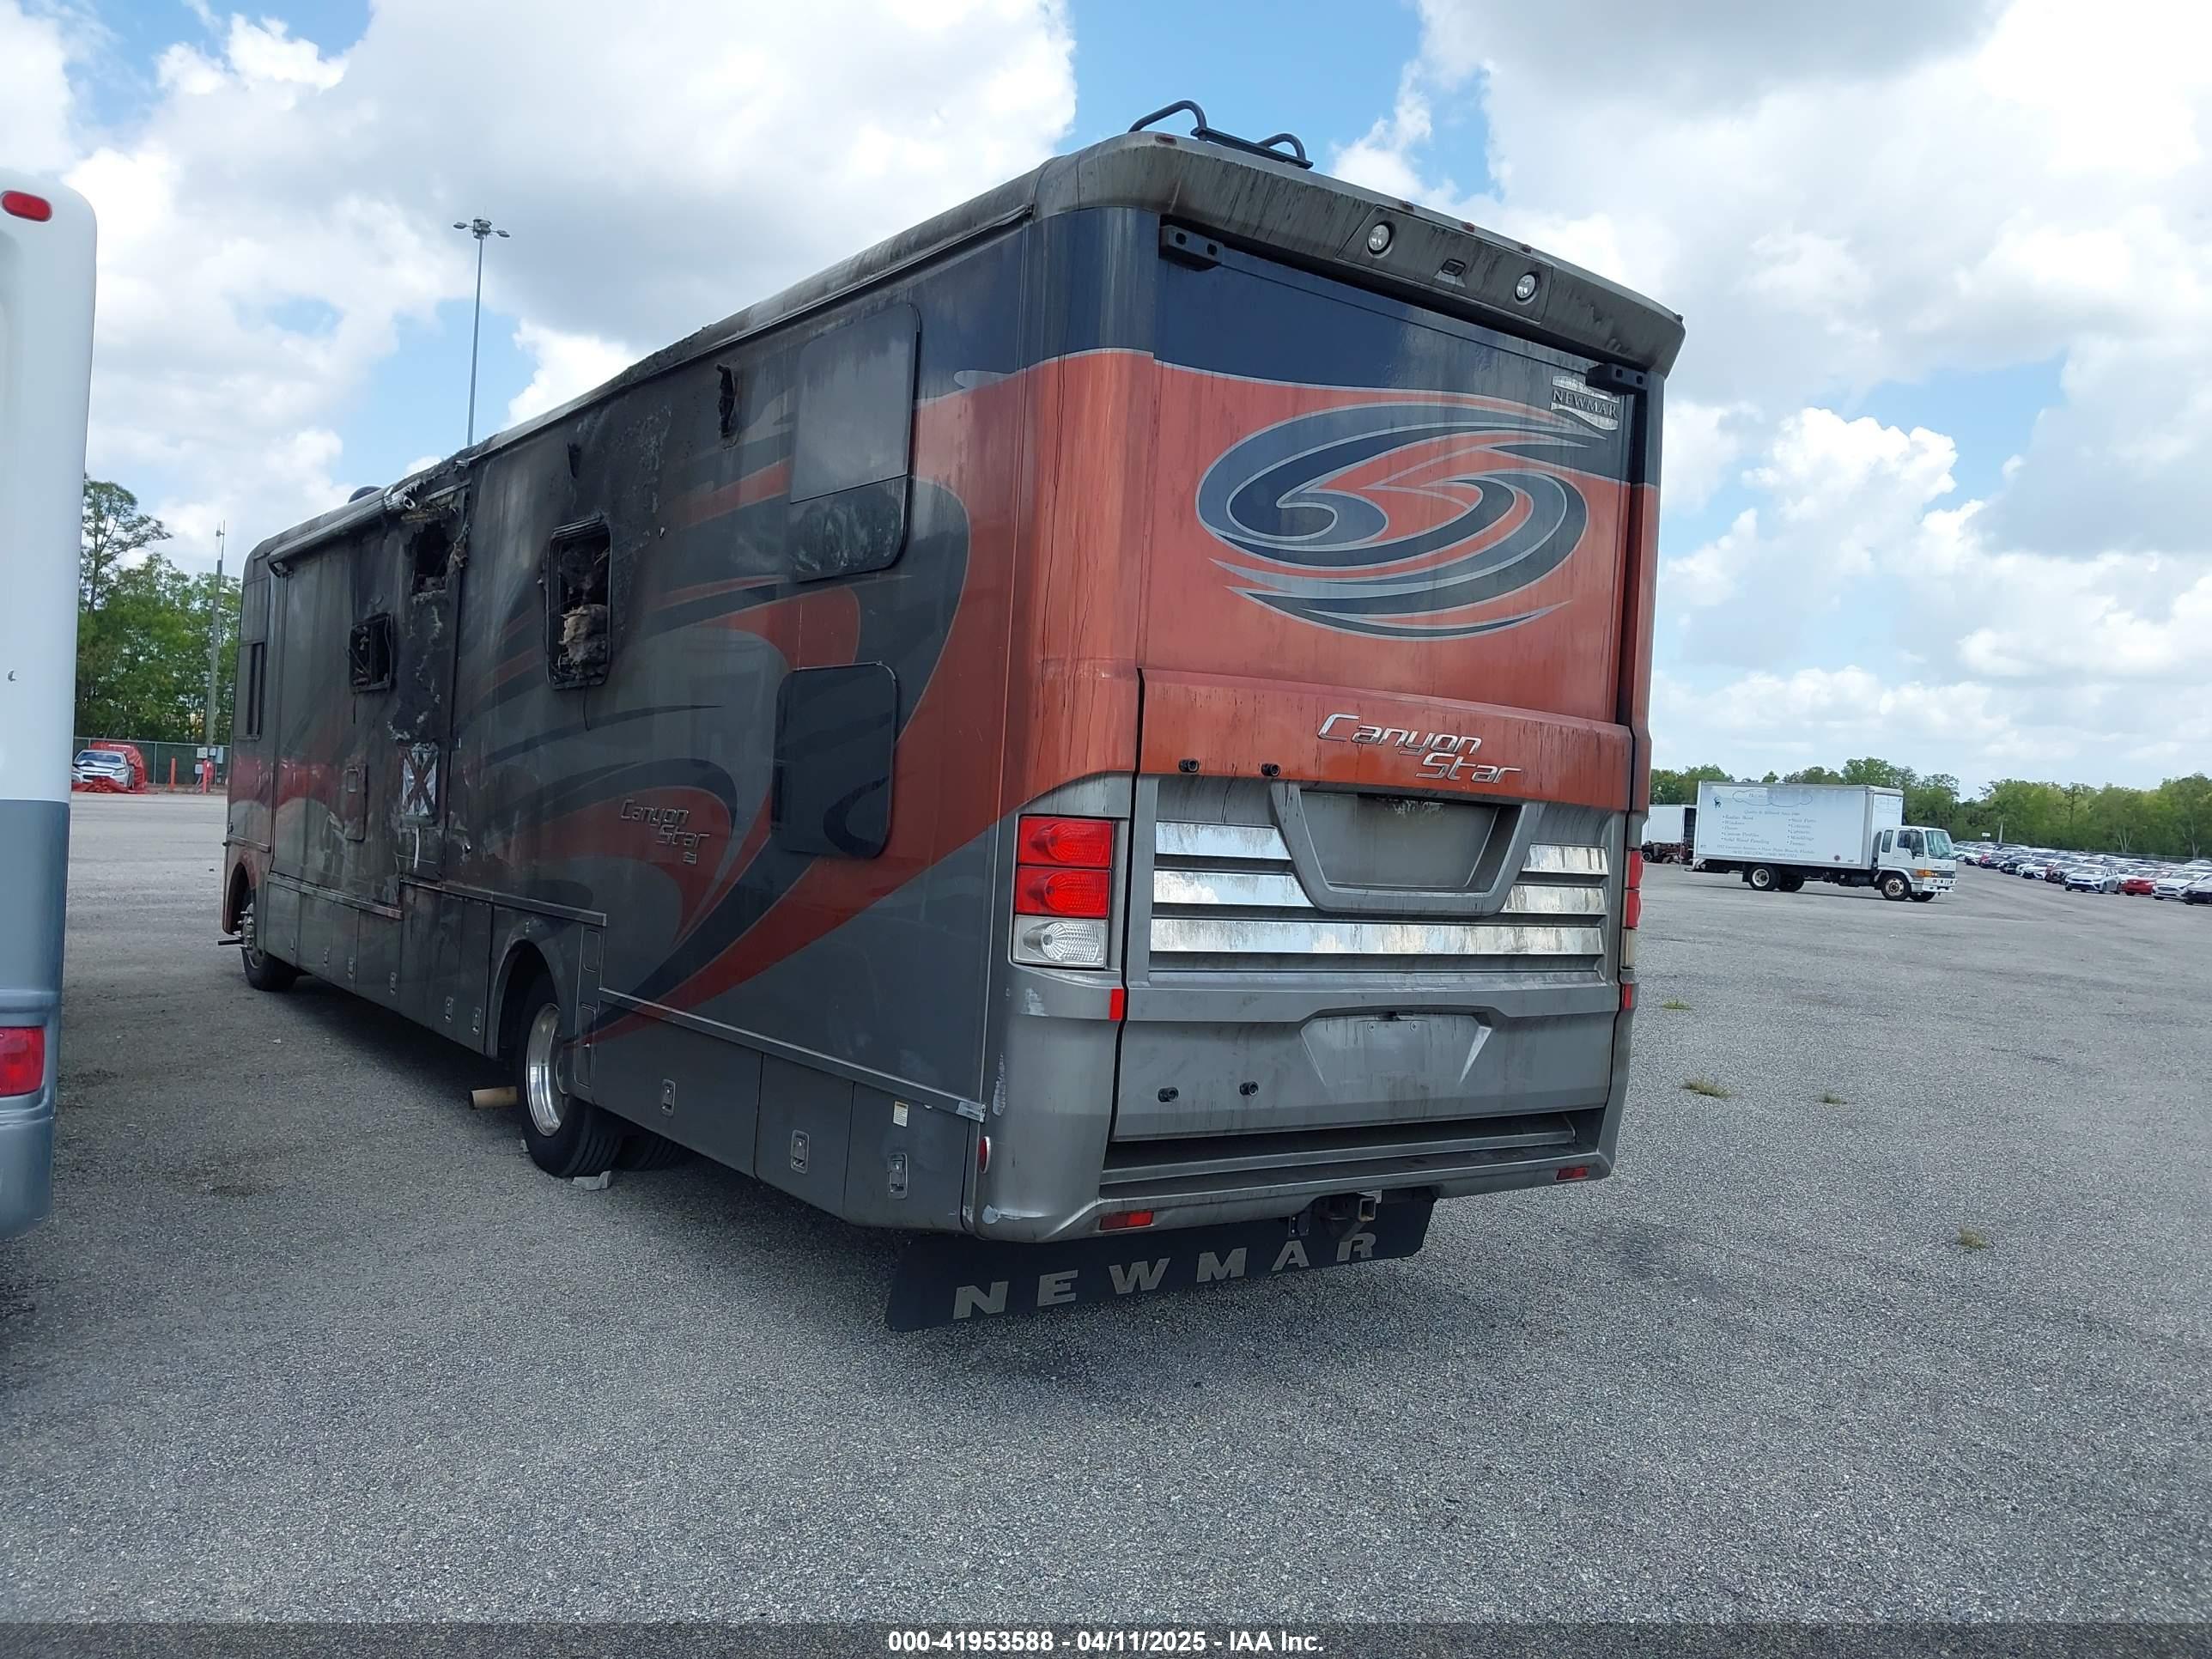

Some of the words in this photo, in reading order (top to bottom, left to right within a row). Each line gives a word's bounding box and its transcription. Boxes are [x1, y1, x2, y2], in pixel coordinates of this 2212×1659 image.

[1552, 390, 1618, 418] NEWMAR
[1317, 713, 1482, 756] Canyon
[1415, 752, 1522, 783] Star
[620, 799, 689, 825] Canyon
[656, 825, 710, 848] Star
